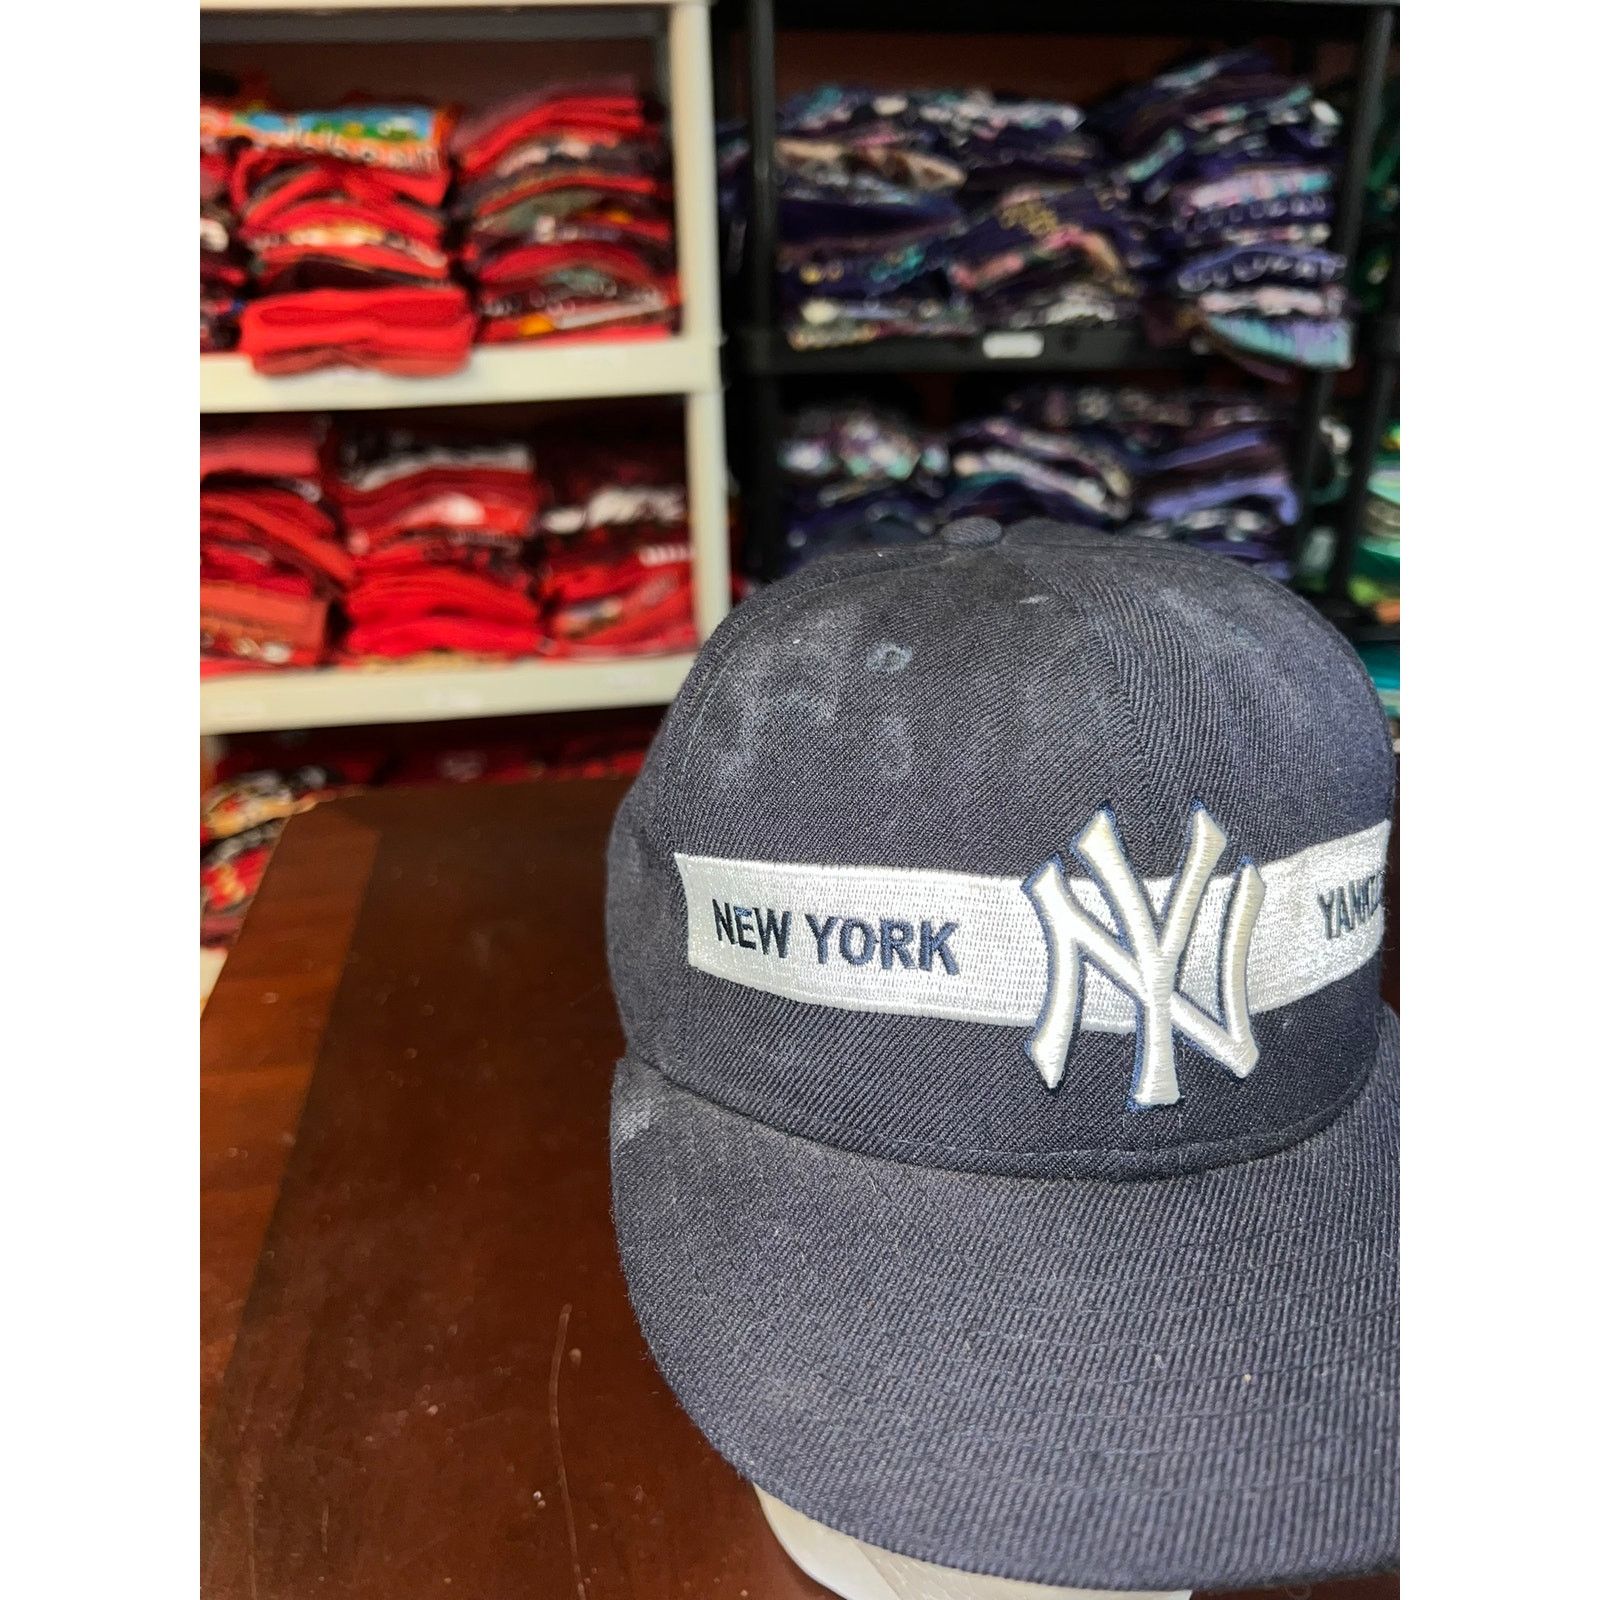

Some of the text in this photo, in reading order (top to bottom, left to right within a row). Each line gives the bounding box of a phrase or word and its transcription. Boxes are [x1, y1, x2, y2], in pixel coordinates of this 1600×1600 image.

[712, 899, 960, 976] NEW YORK
[1020, 796, 1266, 1112] NY
